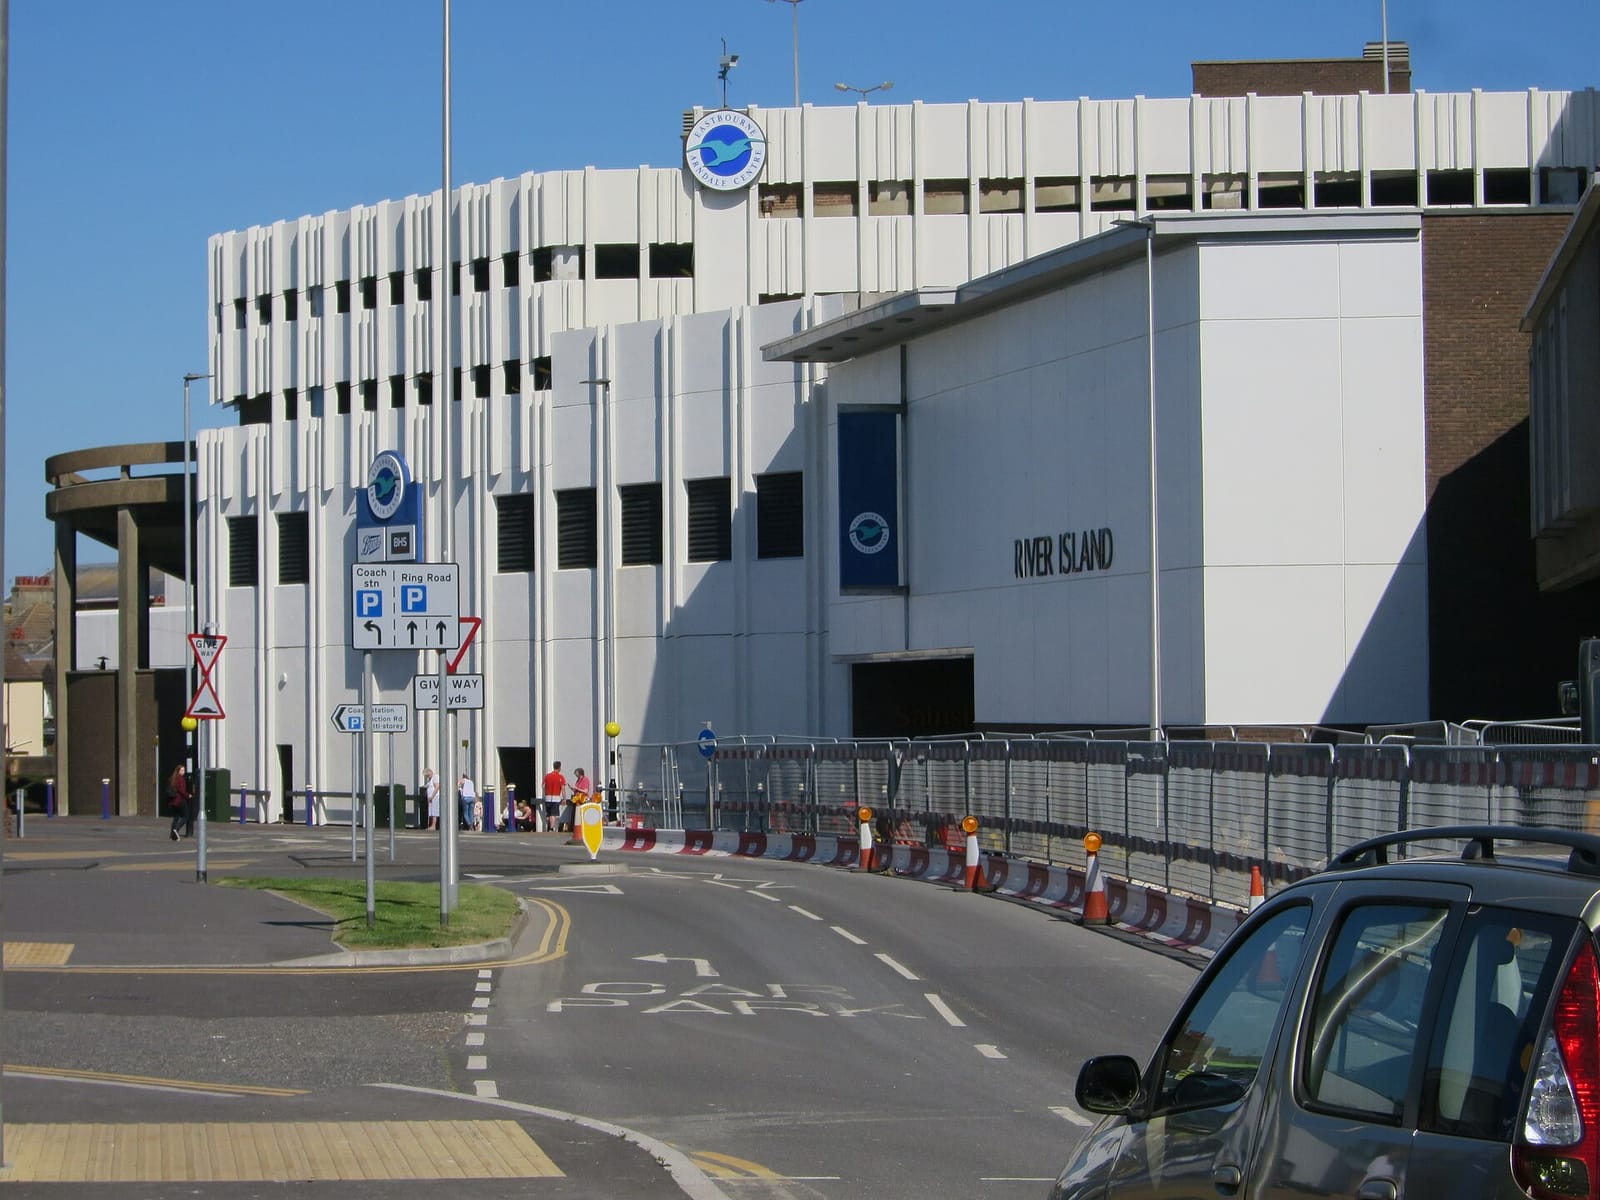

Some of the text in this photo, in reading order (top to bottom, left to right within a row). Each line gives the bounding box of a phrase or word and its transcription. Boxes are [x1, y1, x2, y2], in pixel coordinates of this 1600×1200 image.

[694, 114, 757, 138] EASTBOURNE
[690, 148, 762, 187] ARNDALE CENTRE
[393, 536, 408, 548] BHS
[1014, 527, 1114, 579] RIVER ISLAND
[356, 567, 387, 577] Coach
[363, 579, 380, 588] stn
[401, 573, 452, 584] Ring Road
[196, 640, 217, 648] GIVE
[419, 679, 479, 690] GIV WAY
[448, 693, 468, 706] yds
[580, 982, 856, 1000] CAR
[546, 997, 928, 1018] PARK
